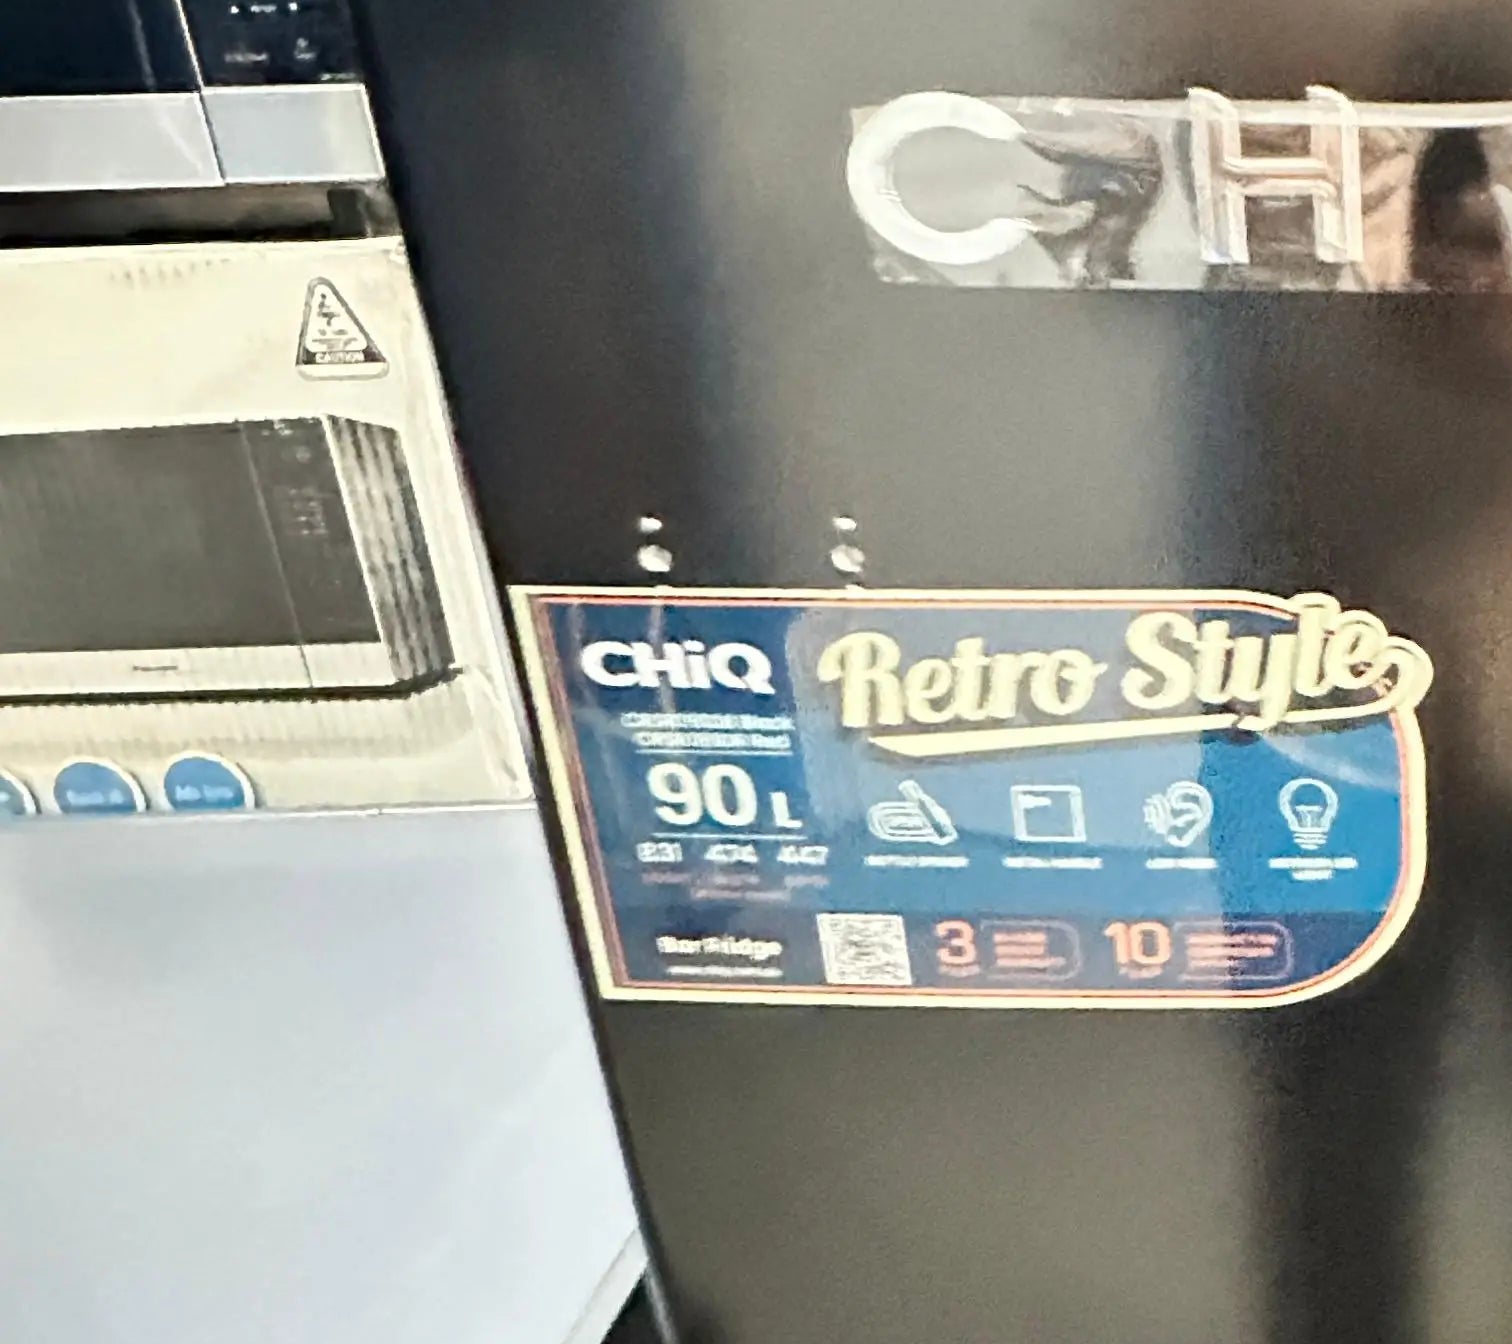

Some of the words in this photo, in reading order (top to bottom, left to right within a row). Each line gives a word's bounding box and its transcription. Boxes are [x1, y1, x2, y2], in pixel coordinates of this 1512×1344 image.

[817, 630, 1107, 728] Retro
[1119, 596, 1405, 732] Style
[647, 762, 758, 827] 90
[769, 791, 803, 829] L
[934, 919, 977, 965] 3
[1103, 920, 1172, 965] 10
